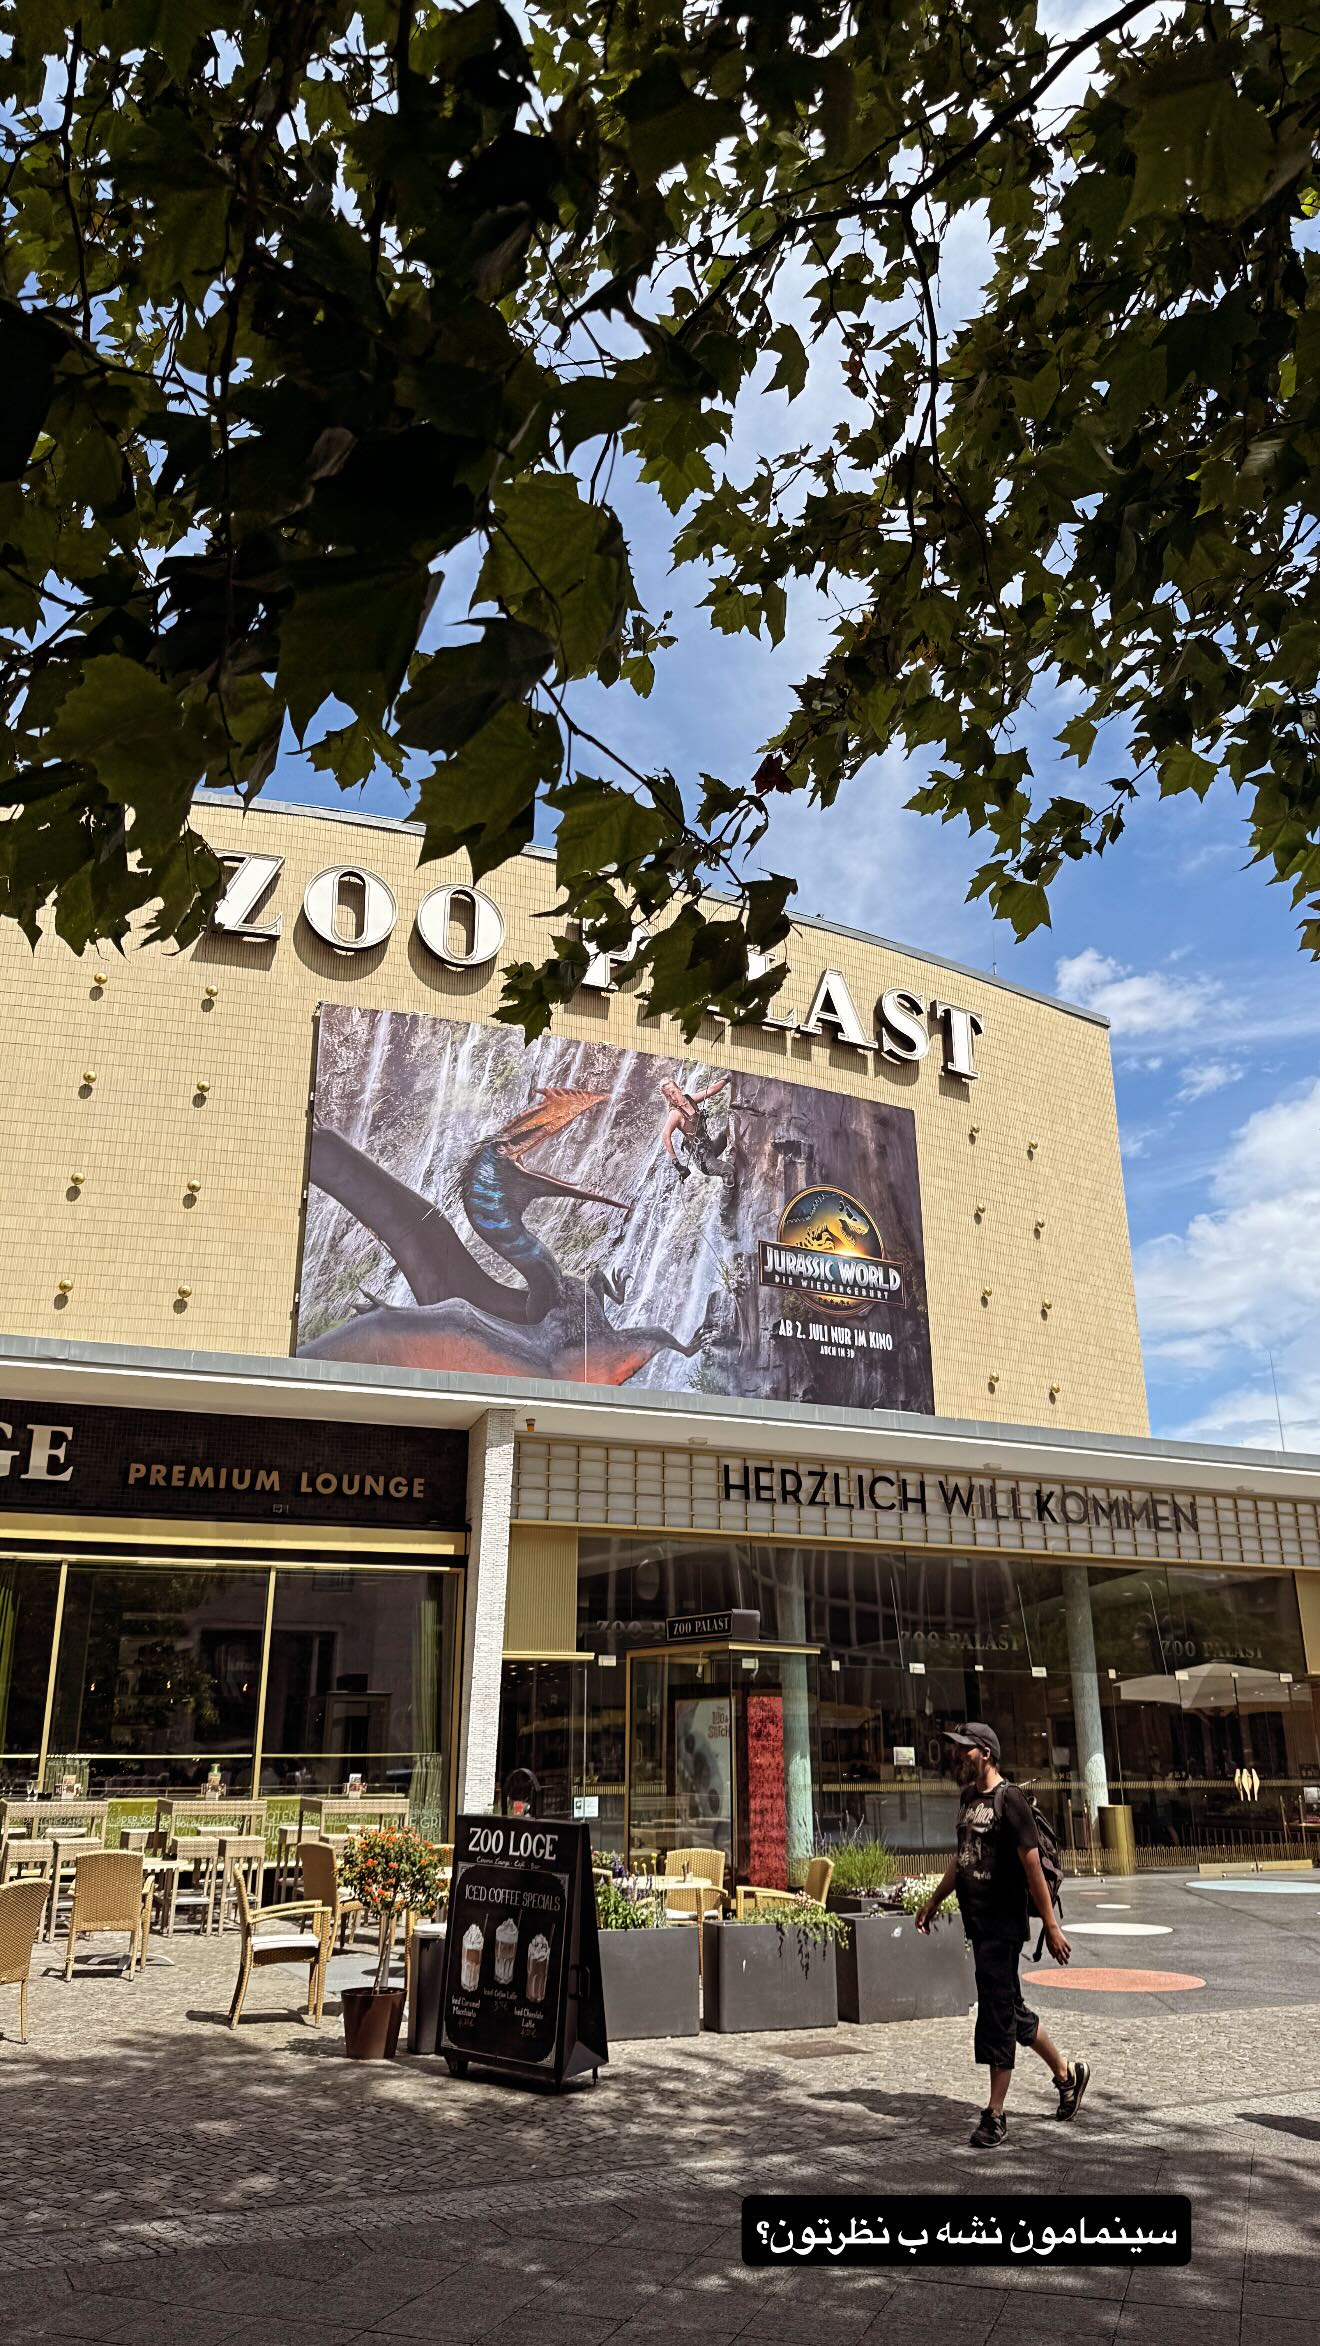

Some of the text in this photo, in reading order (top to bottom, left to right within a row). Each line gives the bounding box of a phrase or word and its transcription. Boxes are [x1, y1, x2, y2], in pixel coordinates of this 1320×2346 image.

[203, 847, 506, 966] ZOO
[764, 1246, 901, 1291] JURASSIC WORLD
[774, 1274, 889, 1300] DIE WIEDERGEBURT
[778, 1319, 893, 1351] AB 2. JULI NUR IM KINO
[820, 1345, 855, 1359] AUCH IN 3D
[128, 1462, 425, 1498] PREMIUM LOUNGE
[723, 1464, 1199, 1533] HERZLICH WILLKOMMEN
[673, 1622, 692, 1636] ZOO
[695, 1617, 730, 1633] PALAST
[948, 1632, 1020, 1650] PALAST
[1160, 1640, 1263, 1659] ZOO PALAST
[468, 1827, 559, 1860] ZOO LOGE
[465, 1884, 561, 1911] ICED COFFEE SPECIALS
